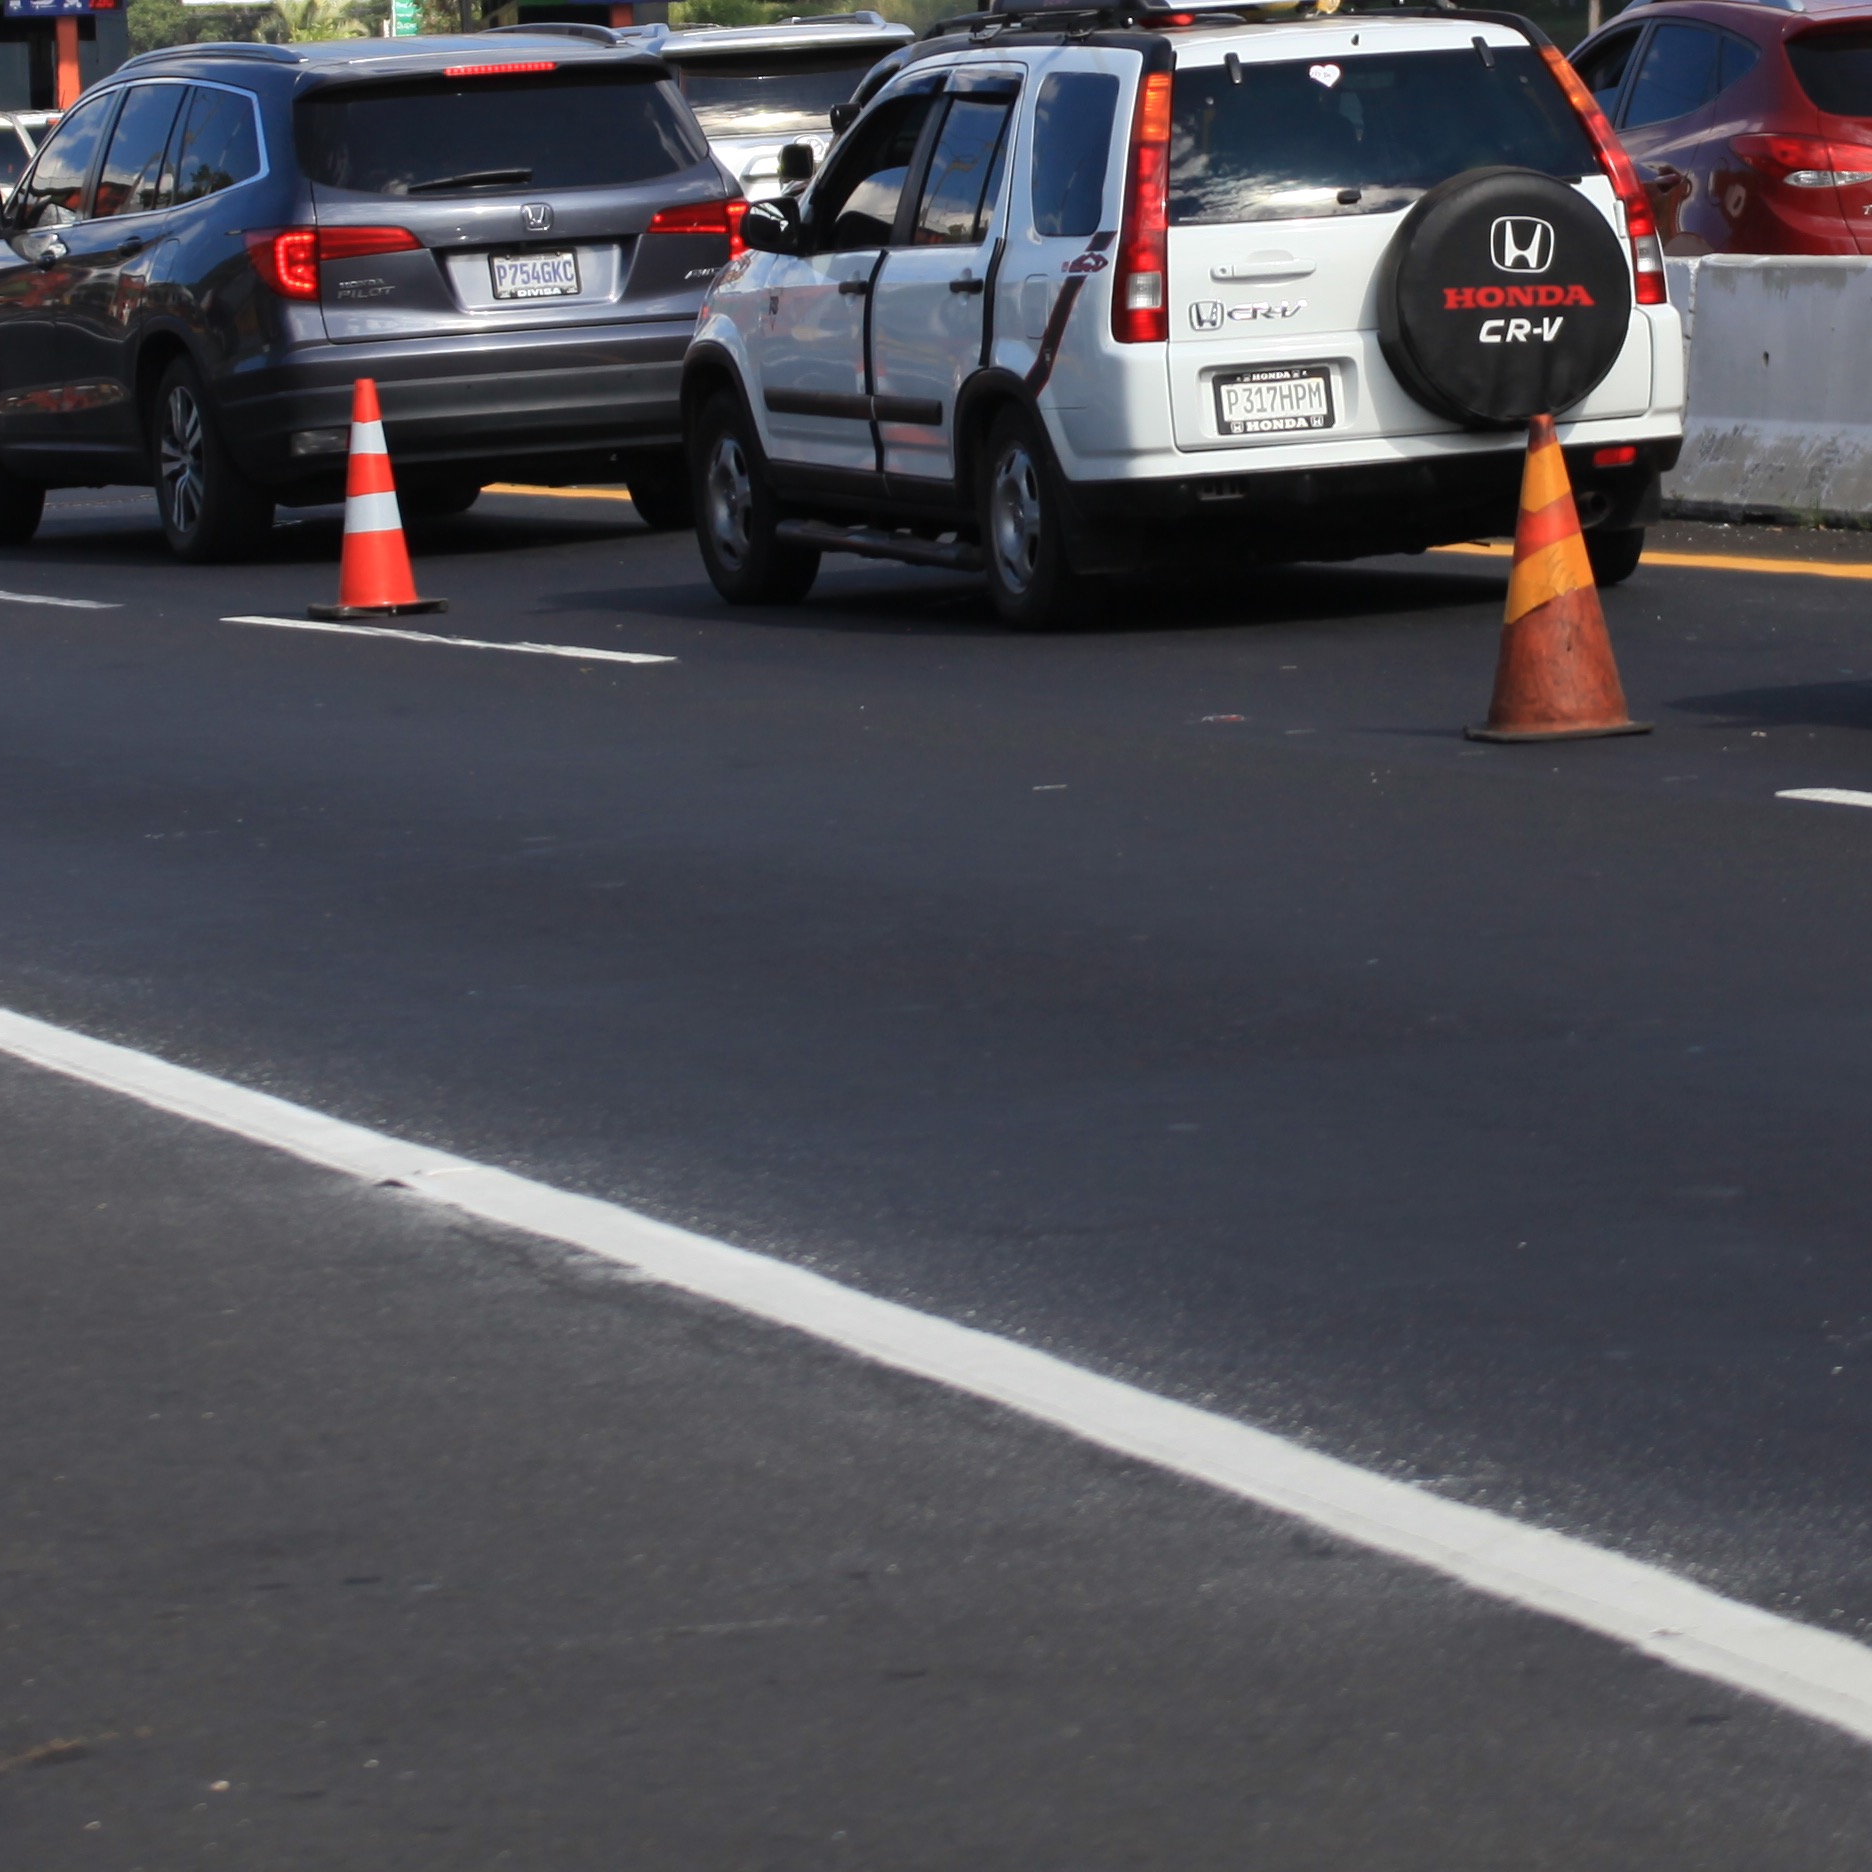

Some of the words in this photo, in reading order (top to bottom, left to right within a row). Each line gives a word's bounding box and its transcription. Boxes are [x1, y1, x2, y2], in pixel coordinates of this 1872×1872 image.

[495, 260, 575, 287] P754GKC
[338, 286, 396, 299] PILOT
[517, 288, 562, 298] DIVISA
[1443, 285, 1596, 310] HONDA
[1226, 299, 1309, 321] CR-V
[1479, 316, 1564, 344] CR-V
[1252, 370, 1291, 381] HONDA
[1246, 415, 1309, 432] HONDA
